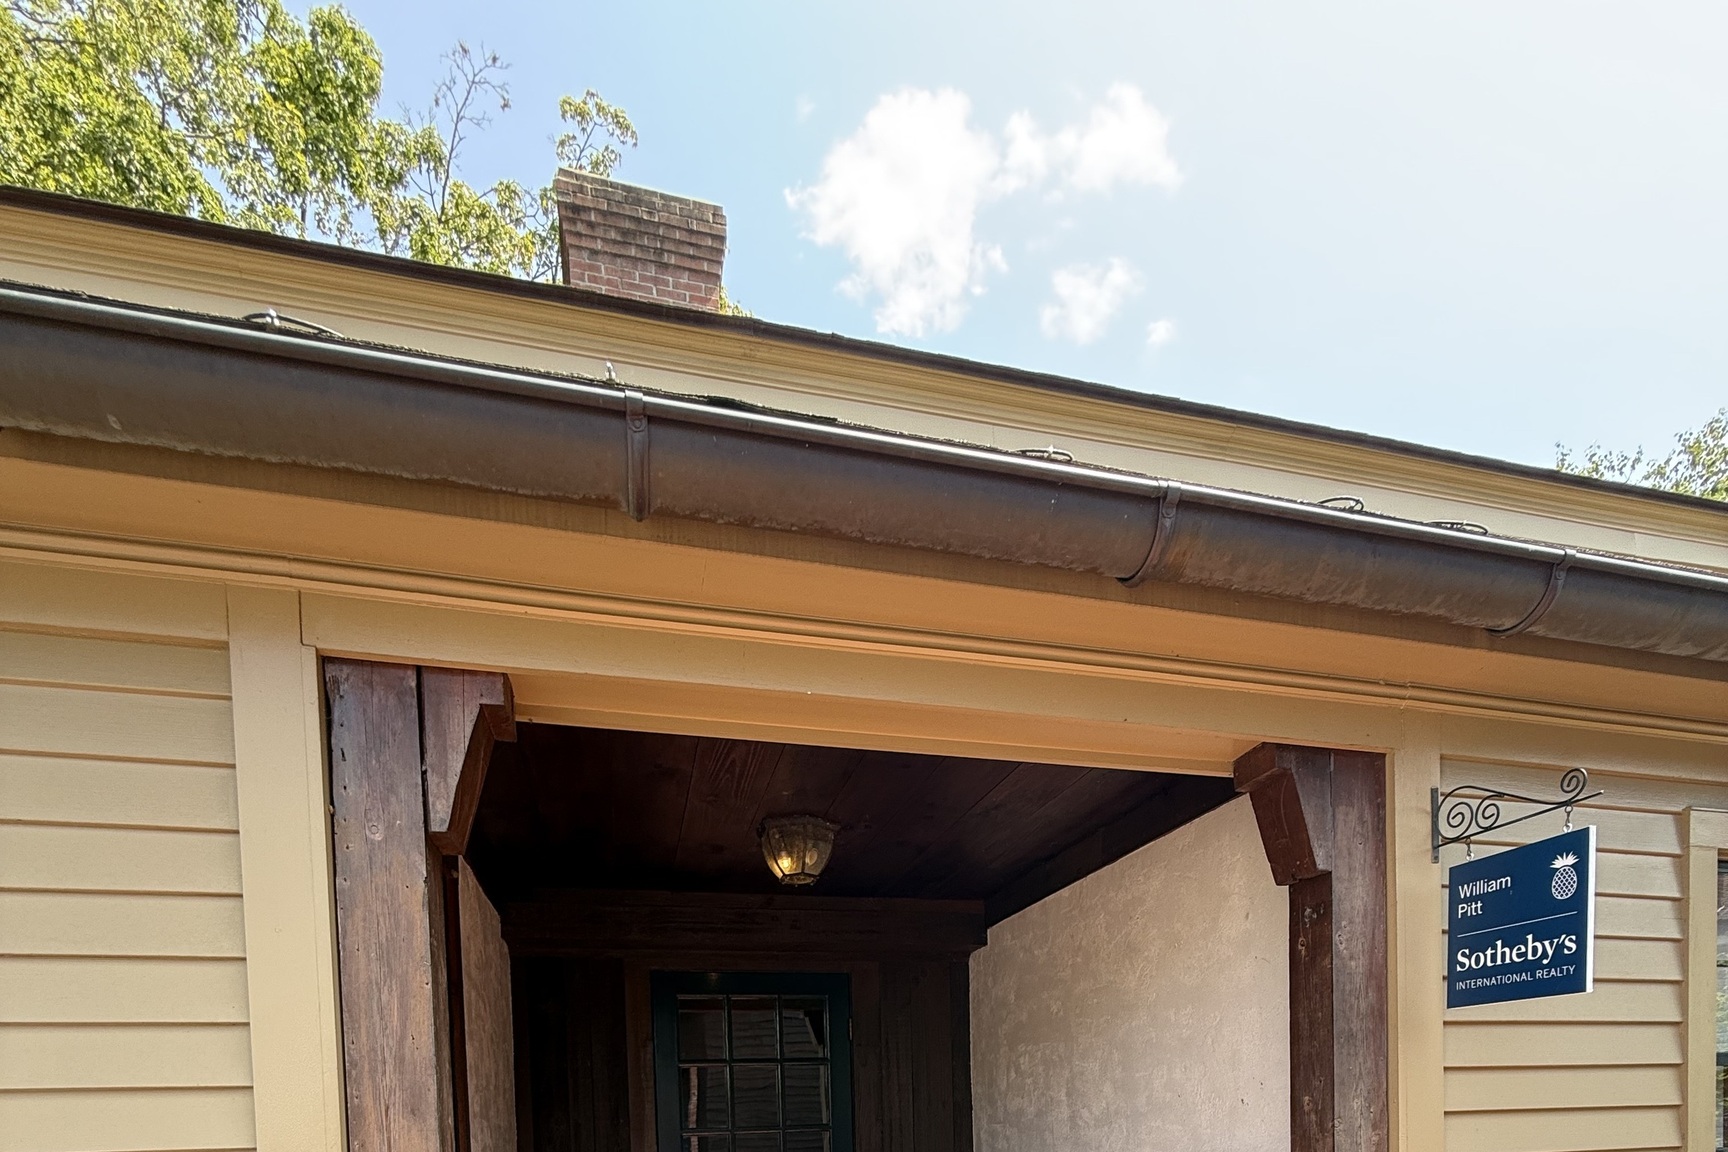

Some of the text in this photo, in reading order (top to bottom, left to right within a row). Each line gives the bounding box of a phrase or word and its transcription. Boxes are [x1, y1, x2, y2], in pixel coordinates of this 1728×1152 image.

[1458, 876, 1511, 899] William
[1458, 900, 1483, 919] Pitt
[1456, 933, 1577, 972] Sotheby's
[1456, 965, 1576, 990] INTERNATIONAL REALTY
